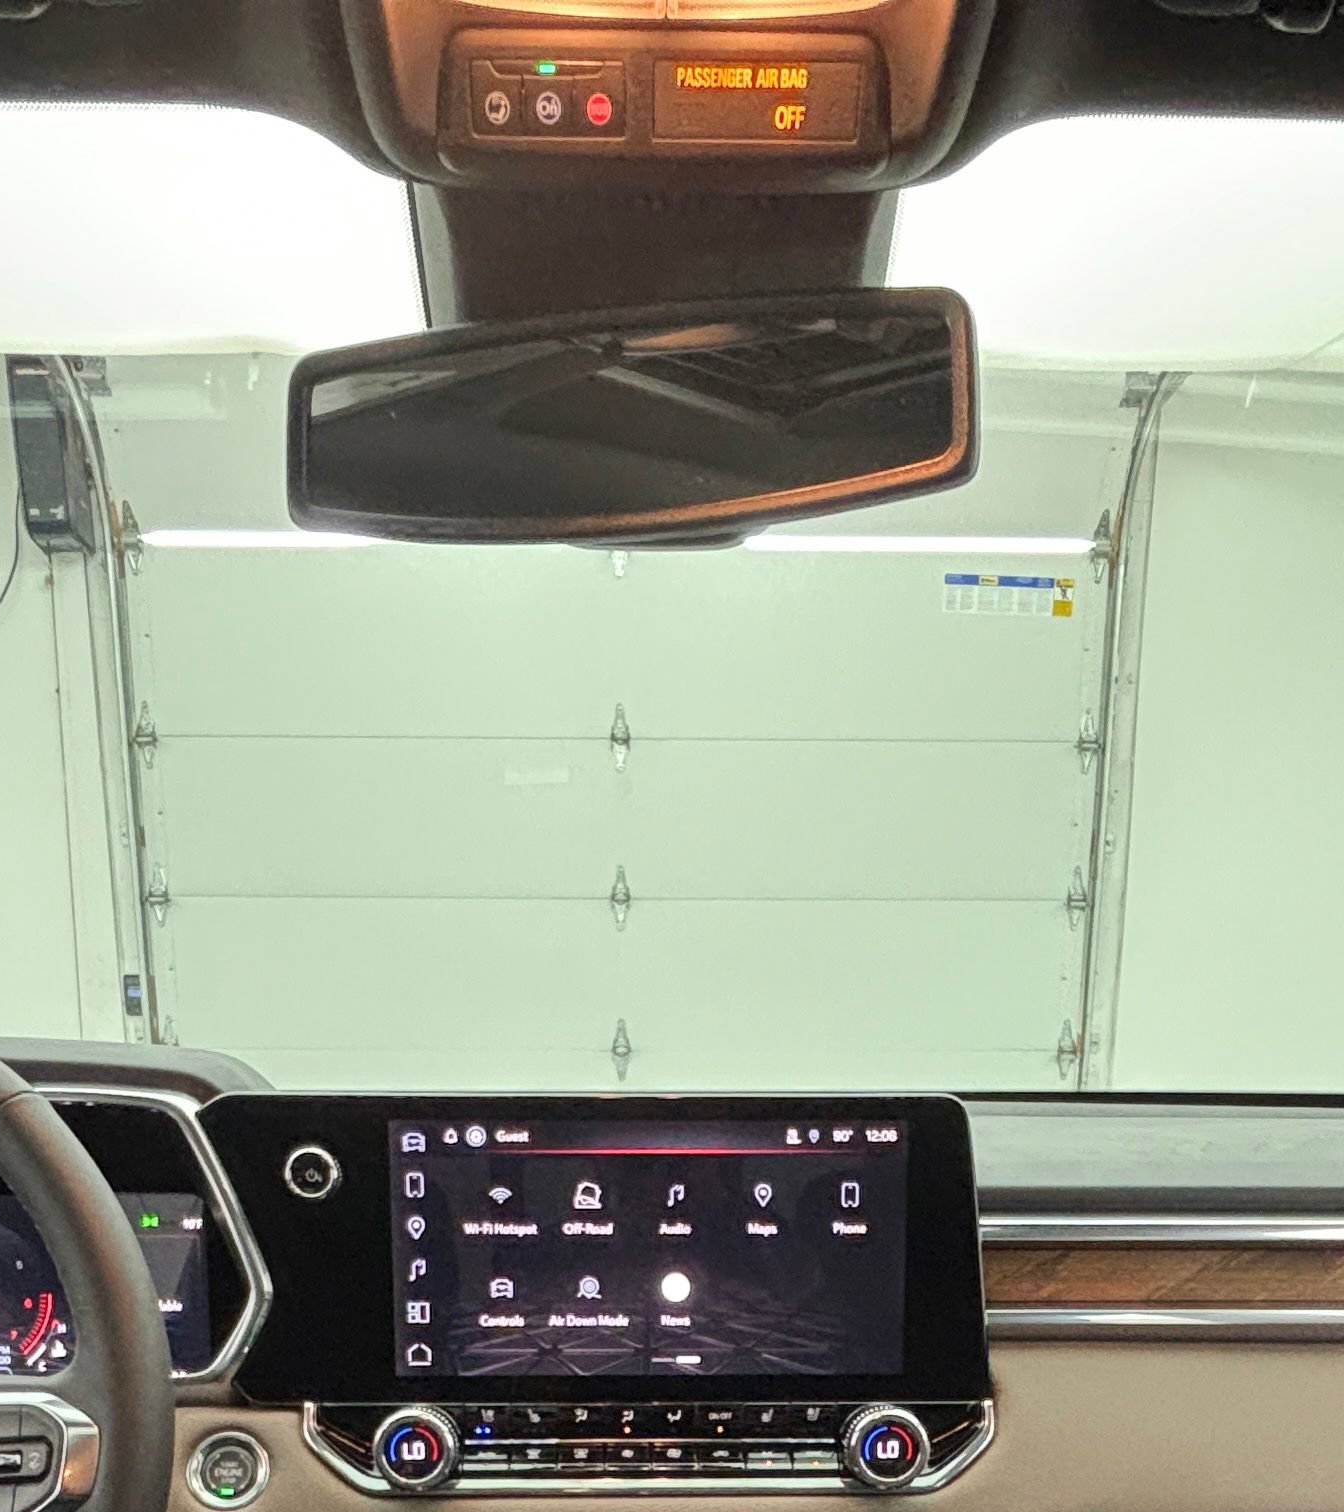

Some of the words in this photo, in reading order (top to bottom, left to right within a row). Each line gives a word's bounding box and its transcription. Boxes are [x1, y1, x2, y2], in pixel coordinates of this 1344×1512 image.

[676, 67, 753, 88] PASSENGER
[756, 69, 778, 88] AIR
[780, 68, 807, 88] BAG
[775, 105, 806, 129] OFF
[495, 1130, 529, 1143] Guest
[462, 1222, 493, 1235] Wi-Fi
[494, 1222, 538, 1237] Hotspot
[561, 1222, 614, 1235] Off-Road
[659, 1222, 693, 1235] Audio
[747, 1222, 778, 1237] Maps
[832, 1221, 867, 1236] Phone
[479, 1315, 524, 1327] Controls
[549, 1315, 564, 1327] Air
[567, 1315, 597, 1327] Down
[598, 1315, 629, 1327] Mode
[661, 1315, 691, 1326] News
